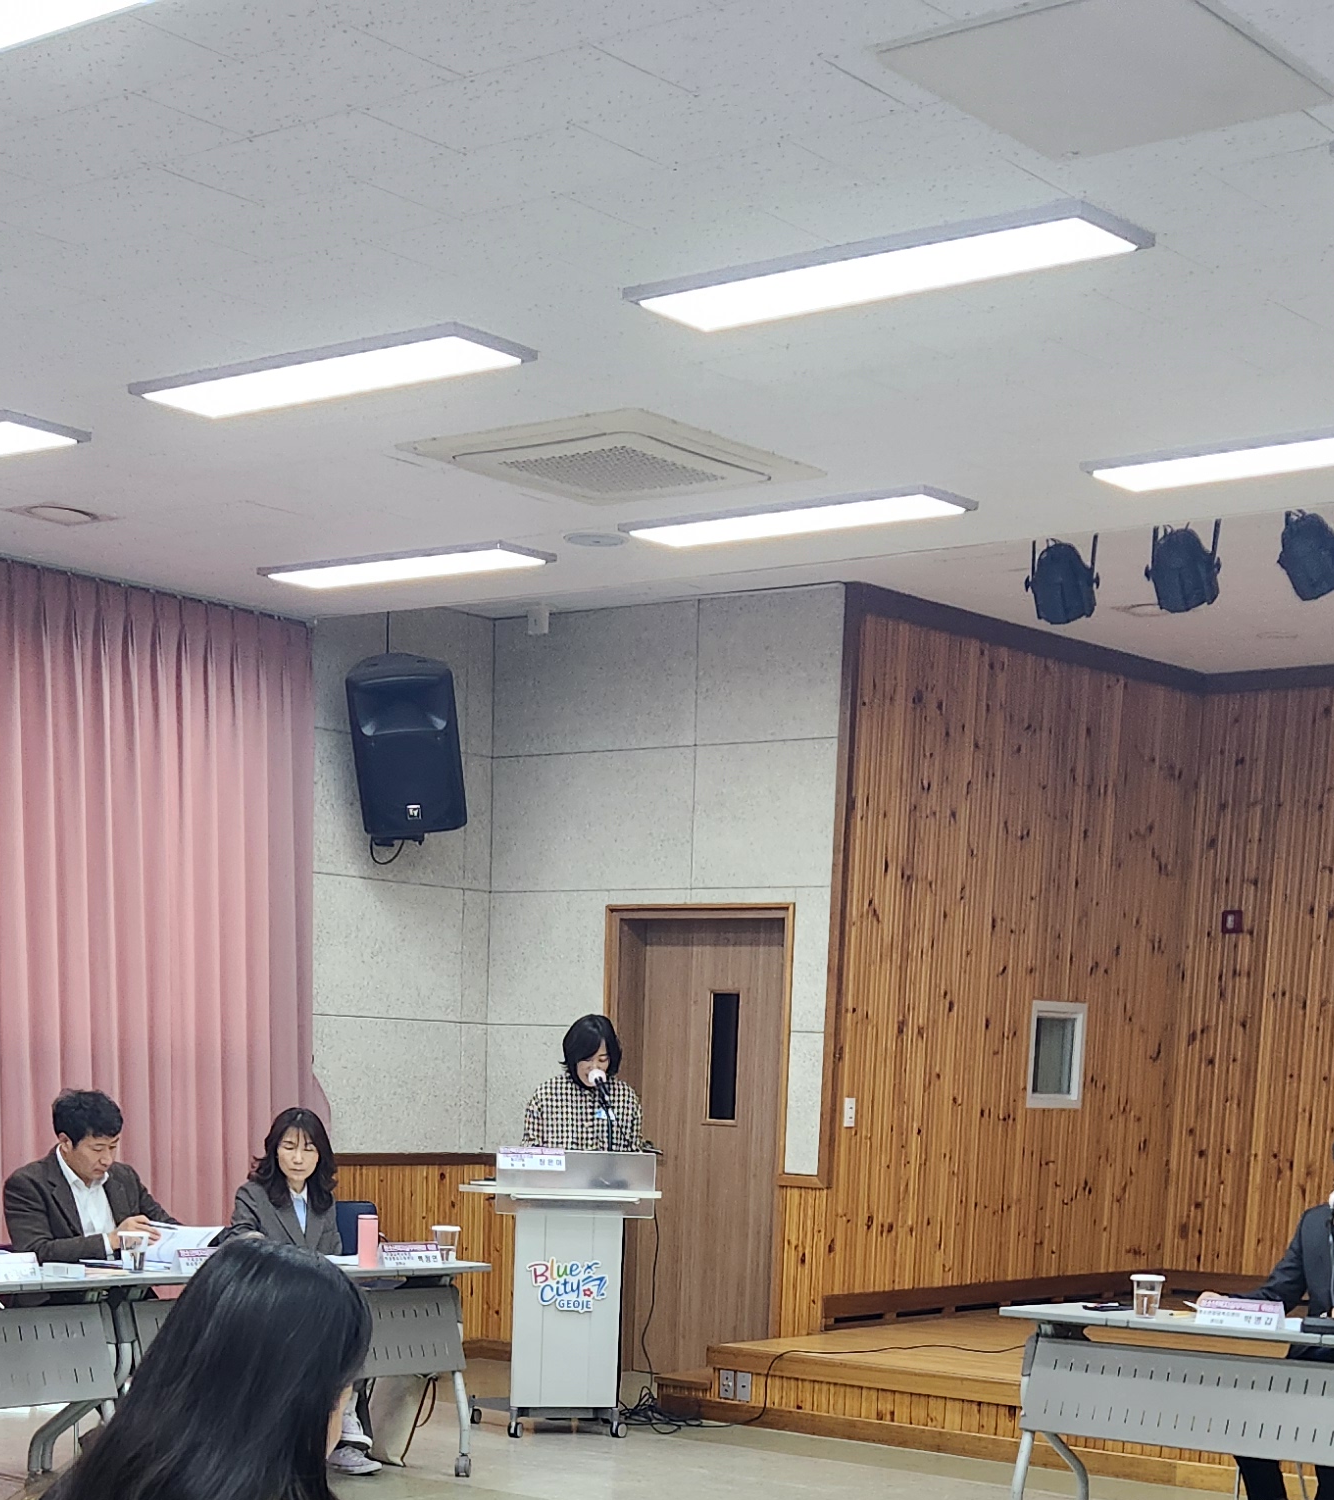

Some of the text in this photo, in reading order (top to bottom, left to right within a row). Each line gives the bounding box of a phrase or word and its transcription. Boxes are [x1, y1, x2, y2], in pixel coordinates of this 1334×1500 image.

[528, 1258, 581, 1284] Blue
[540, 1278, 581, 1303] City
[558, 1299, 592, 1310] GEOJE
